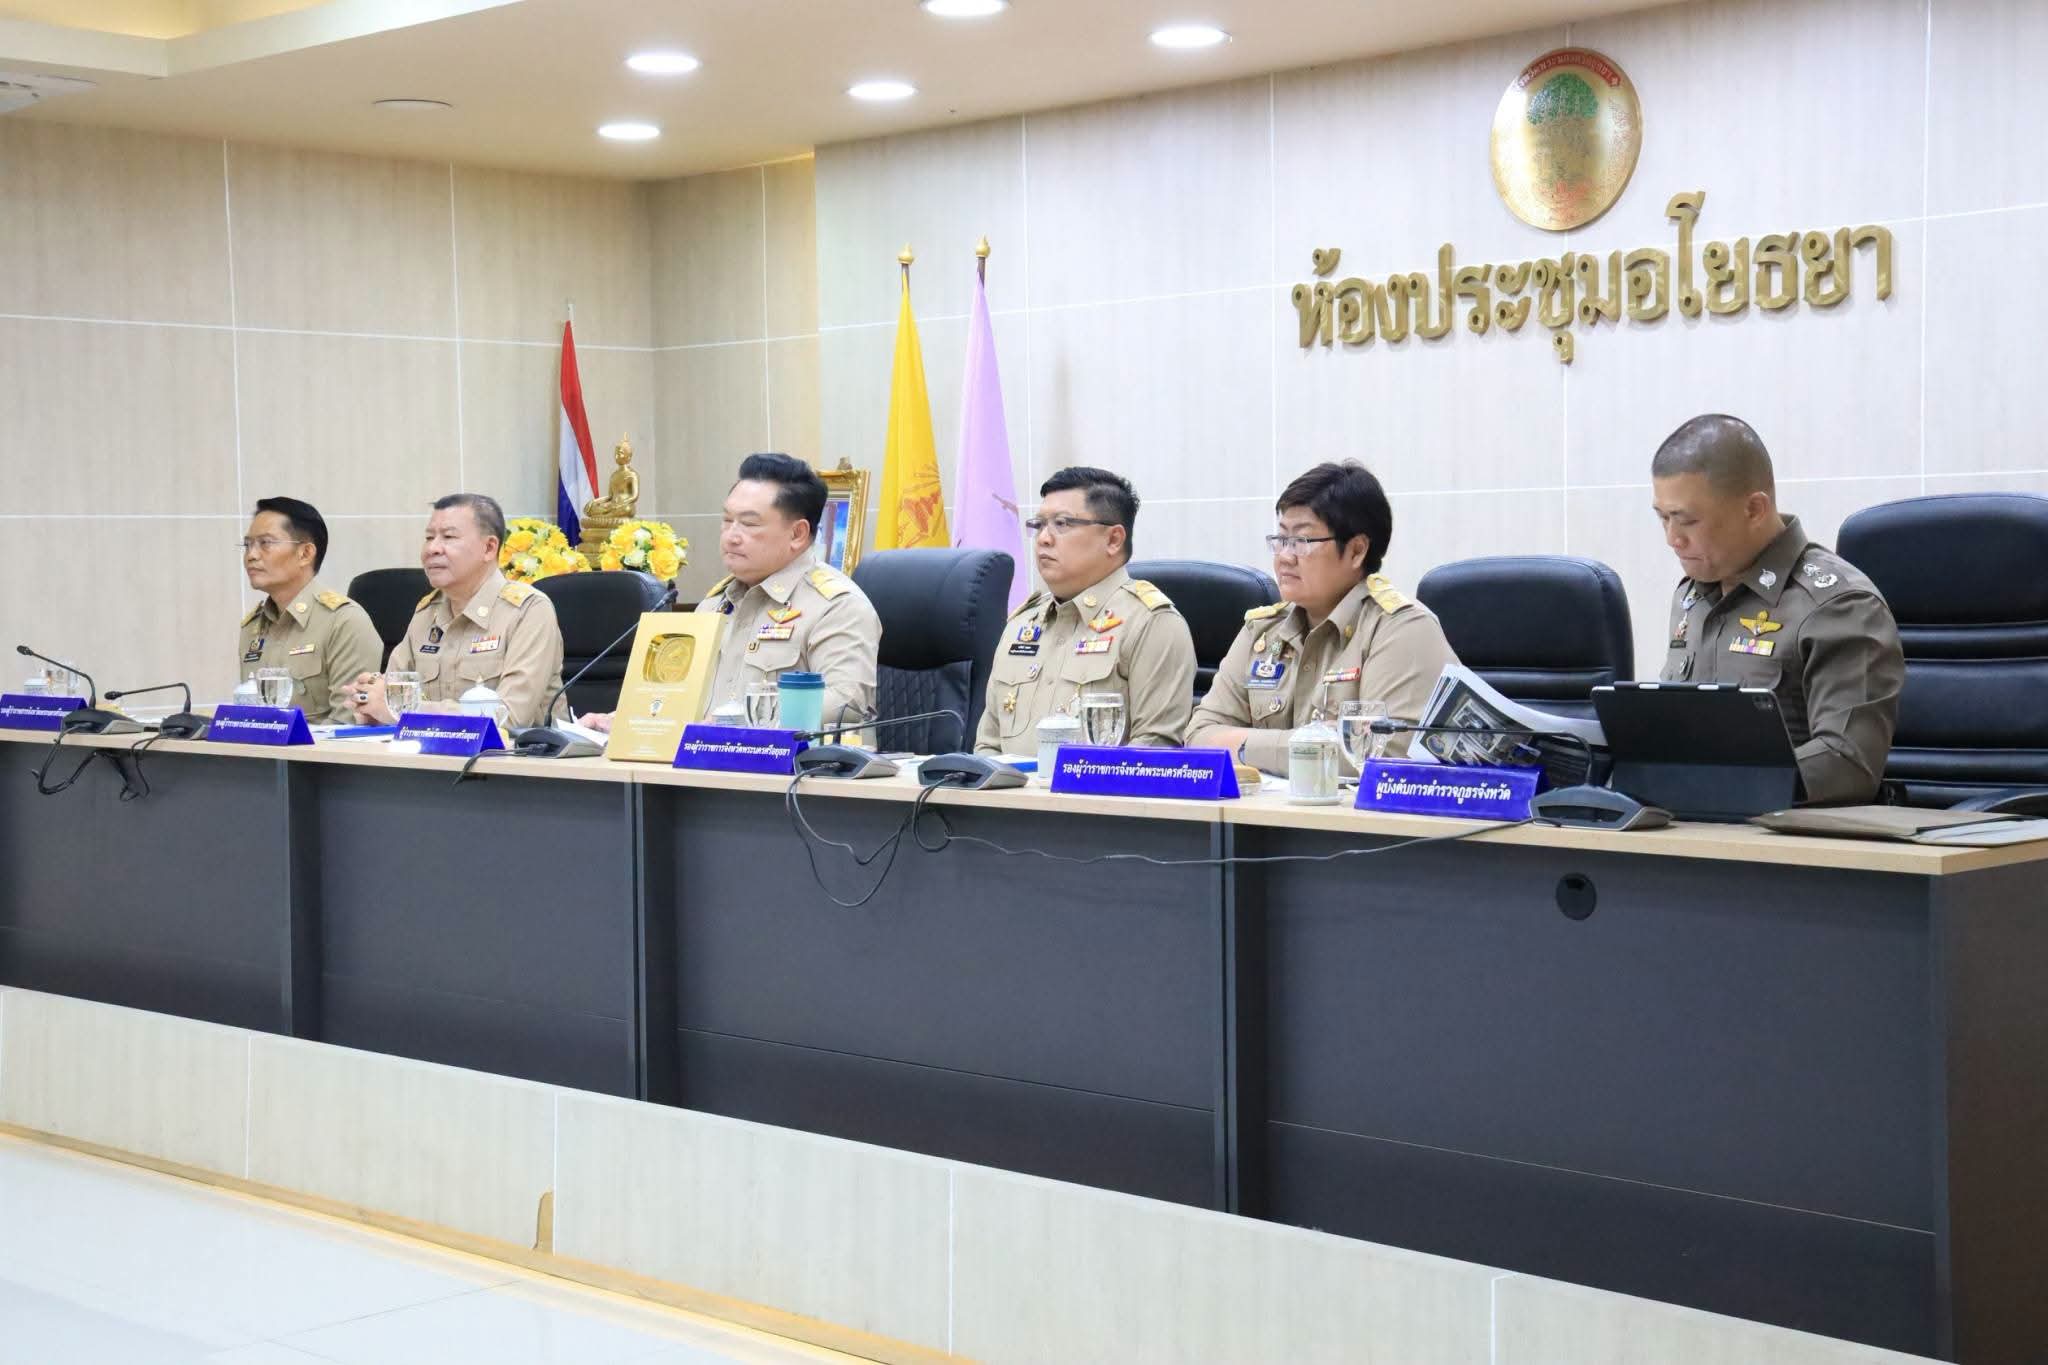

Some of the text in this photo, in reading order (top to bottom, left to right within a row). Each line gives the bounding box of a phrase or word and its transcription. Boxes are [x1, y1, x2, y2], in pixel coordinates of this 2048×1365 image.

[1292, 191, 1893, 364] ห้องประชุมอโยธยา
[1063, 759, 1214, 783] รองผู้ว่าราชการจังหวัดพระนครศรีอยุธยา
[1376, 772, 1511, 805] ผู้บังคับการตำรวจภูธรจังหวัด
